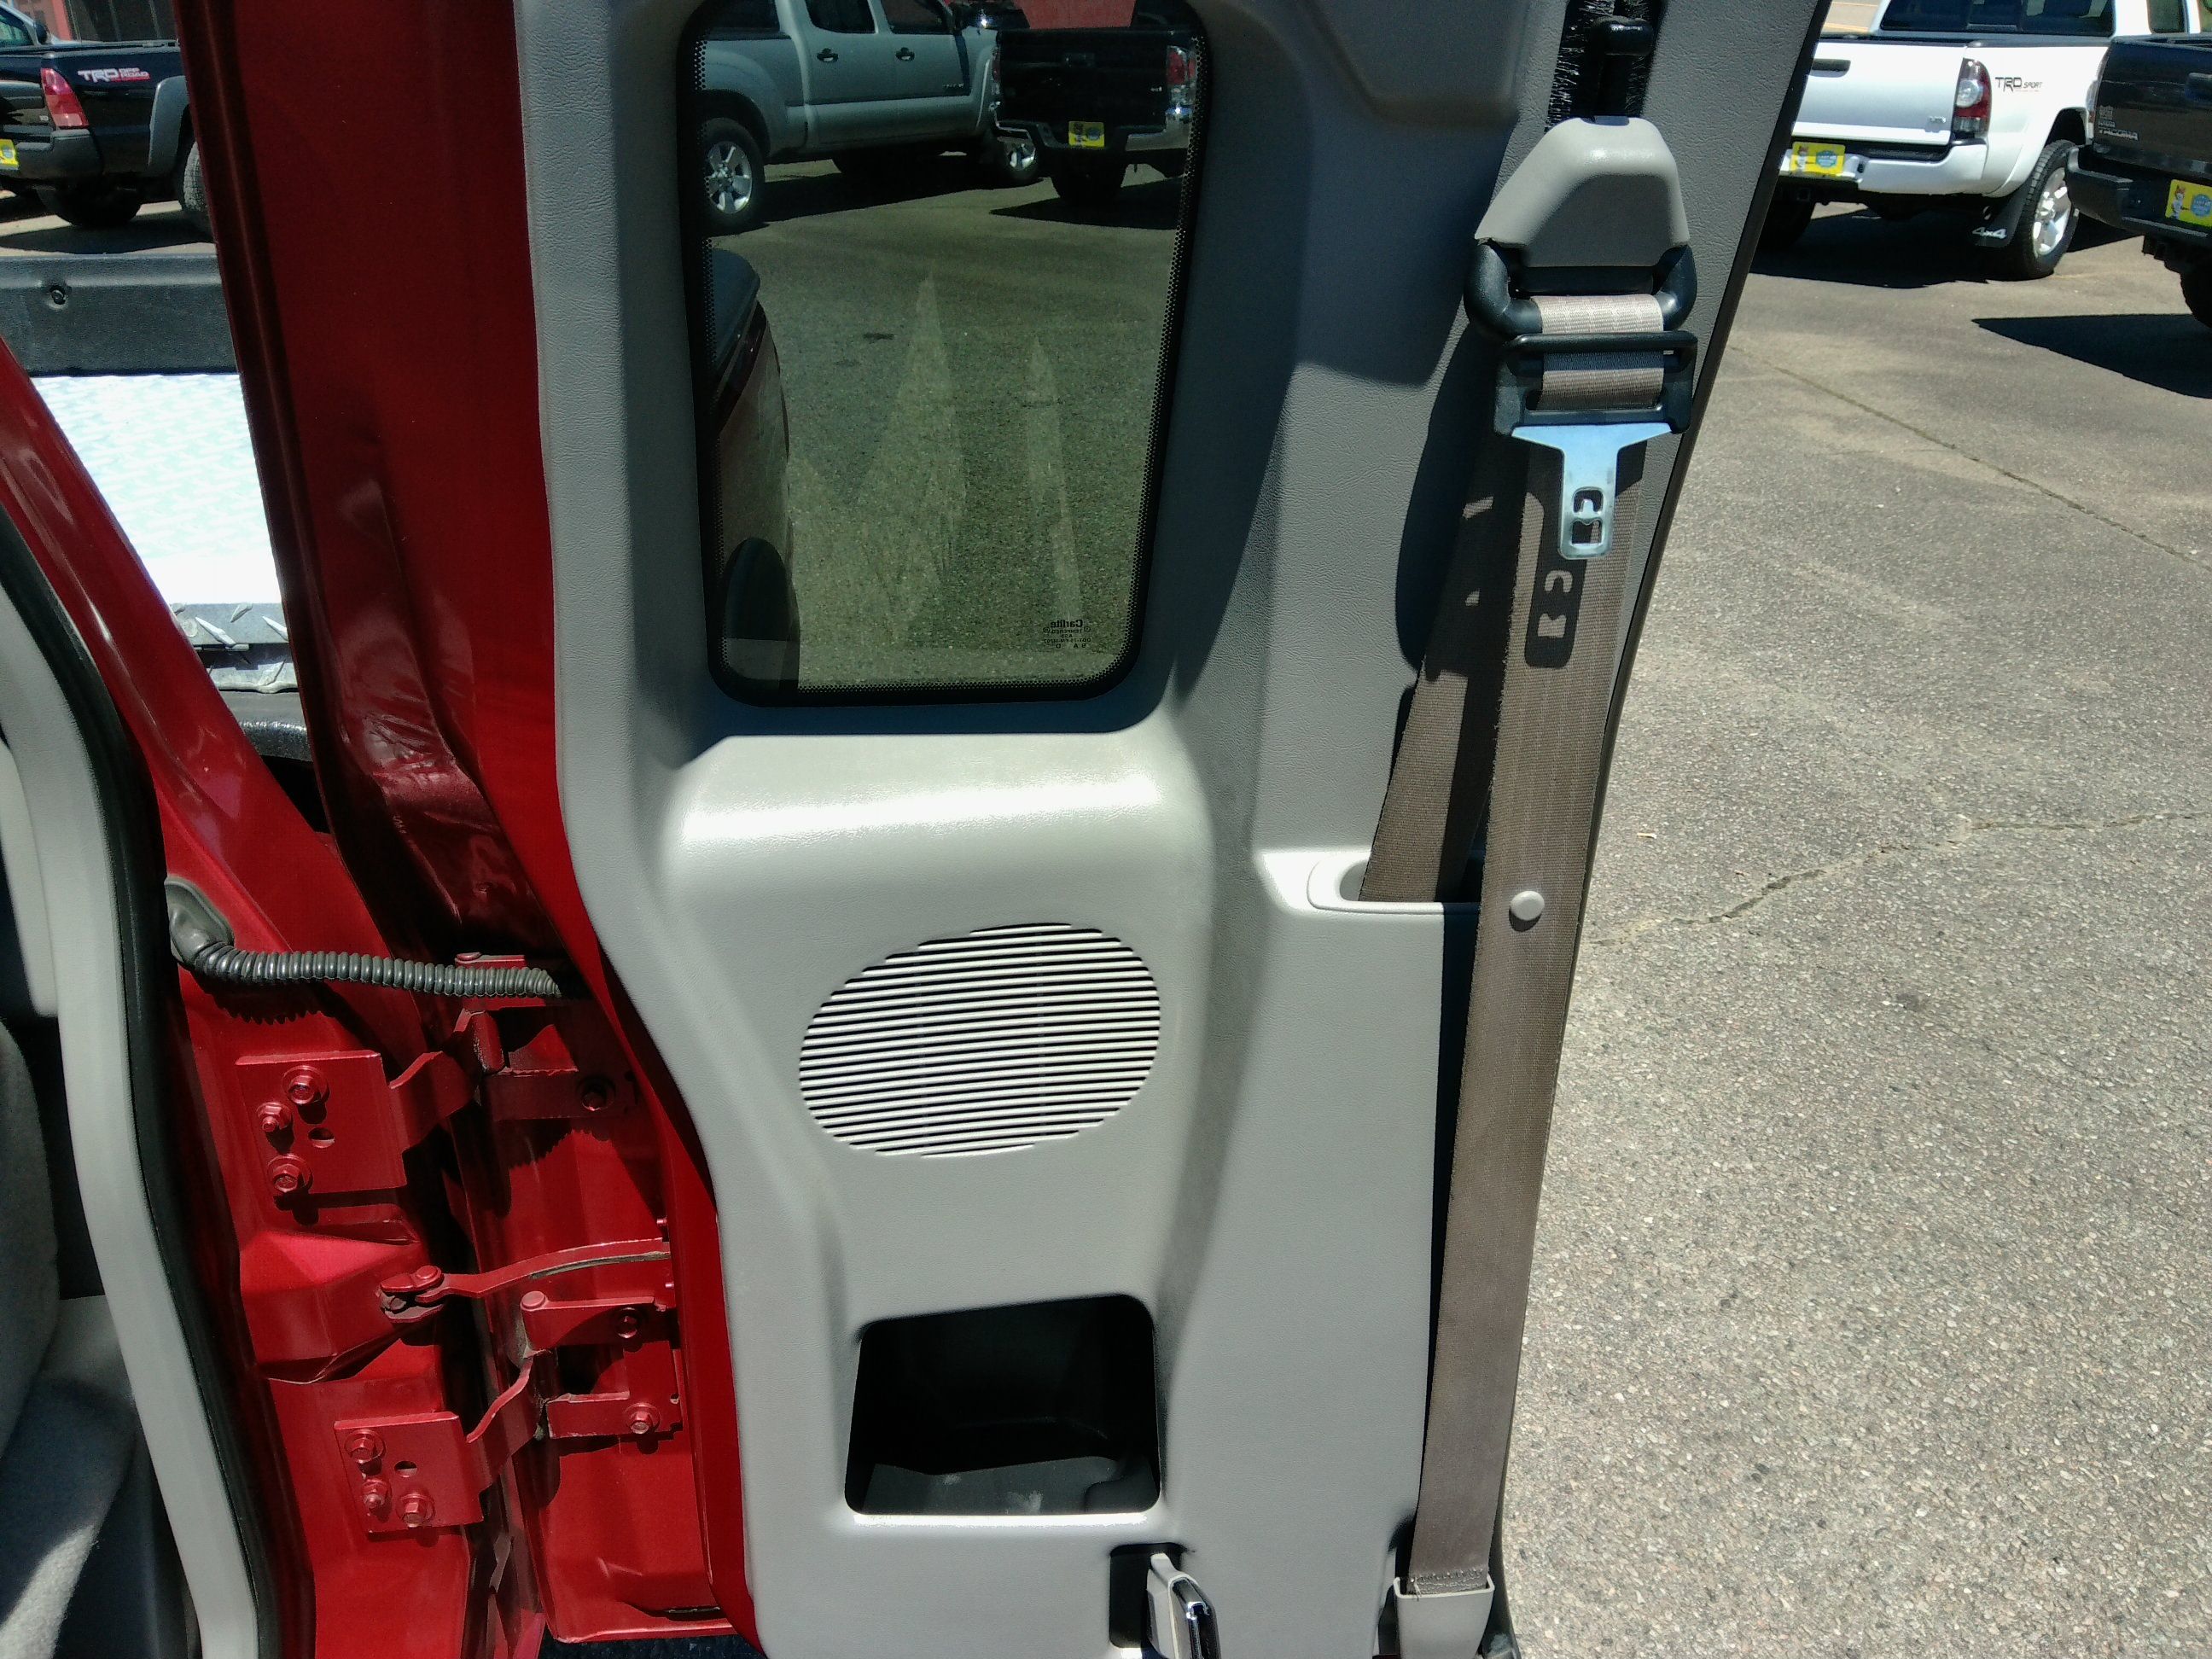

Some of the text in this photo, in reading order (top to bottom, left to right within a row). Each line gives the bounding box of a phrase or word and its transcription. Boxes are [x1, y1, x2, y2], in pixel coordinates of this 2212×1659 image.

[78, 68, 119, 83] TRD
[1995, 77, 2023, 92] TRD
[1972, 227, 2007, 239] 4x4
